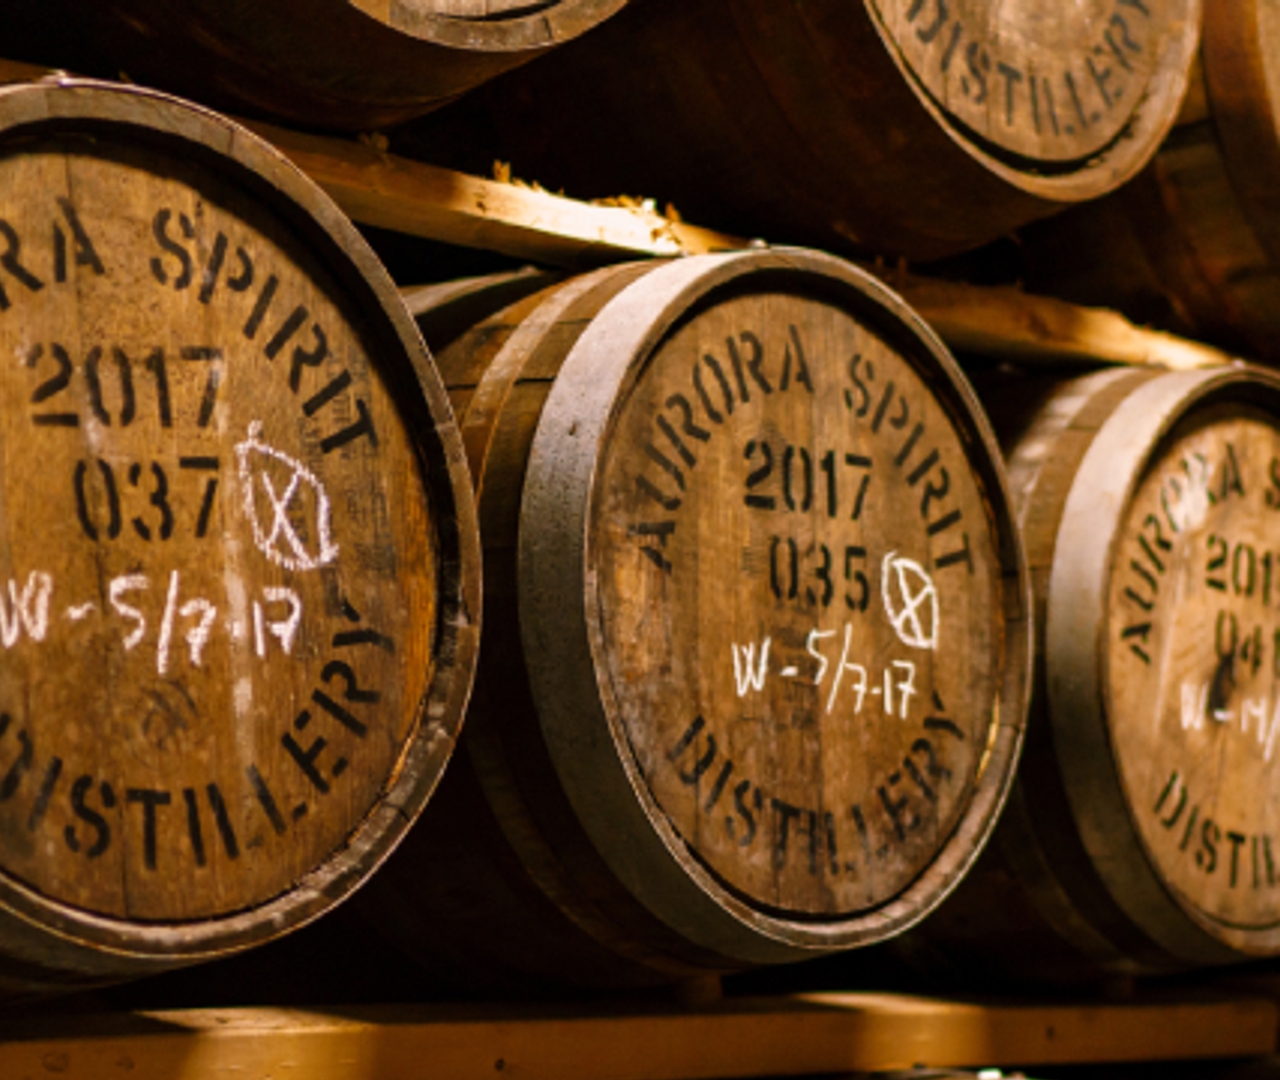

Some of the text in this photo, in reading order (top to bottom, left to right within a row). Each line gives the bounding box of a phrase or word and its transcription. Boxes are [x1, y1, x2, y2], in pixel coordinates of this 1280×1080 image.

[151, 205, 379, 454] SPIRIT
[28, 342, 226, 428] 2017
[627, 324, 815, 576] AURORA
[843, 353, 974, 577] SPIRIT
[743, 439, 874, 520] 2017
[72, 457, 220, 541] 037
[769, 535, 870, 613] 035
[1121, 443, 1245, 665] AURORA
[1206, 533, 1280, 606] 201
[665, 690, 965, 877] DISTILLERY
